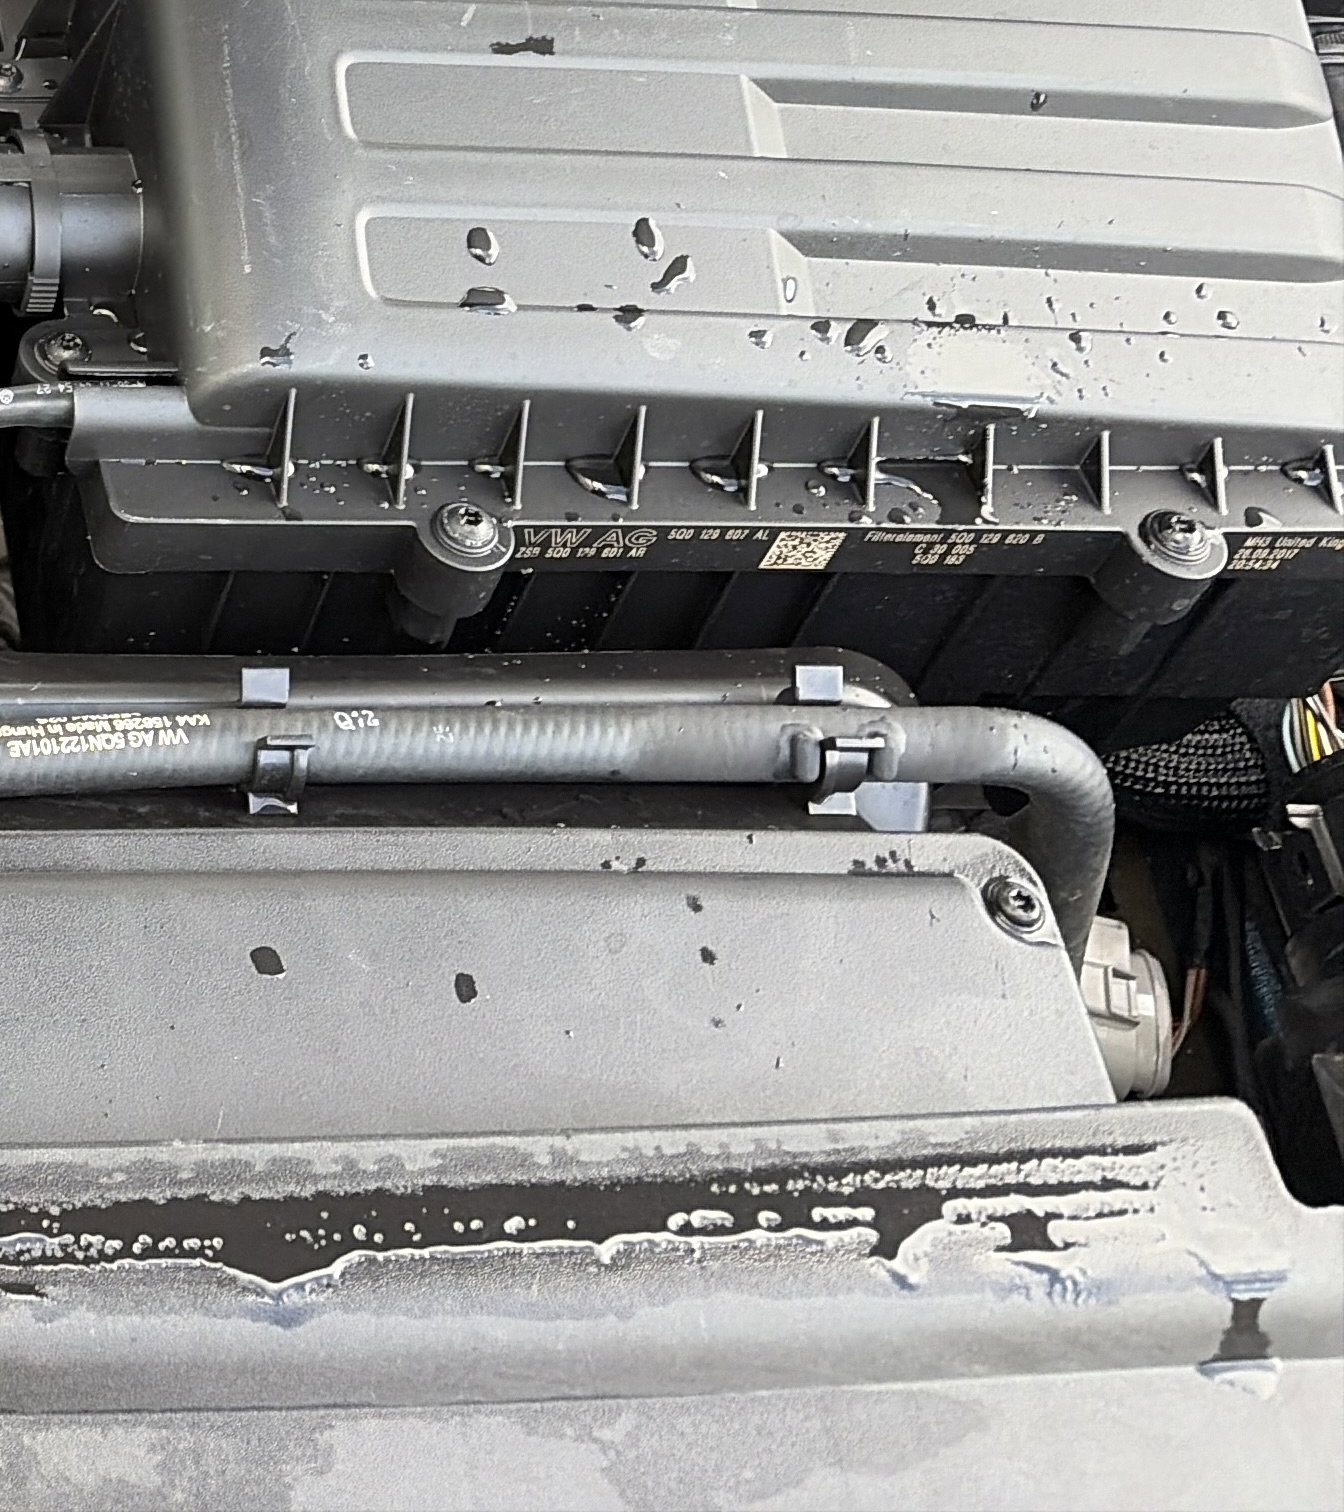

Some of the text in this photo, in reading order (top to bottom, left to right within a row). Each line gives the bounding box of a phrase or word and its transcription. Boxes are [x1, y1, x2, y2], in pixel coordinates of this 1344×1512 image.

[523, 528, 659, 548] VW AG
[1274, 536, 1318, 548] United
[930, 544, 948, 554] 30
[951, 544, 978, 555] 005
[46, 722, 62, 735] in
[64, 718, 111, 733] Made
[128, 728, 154, 748] AG
[157, 727, 188, 746] VW
